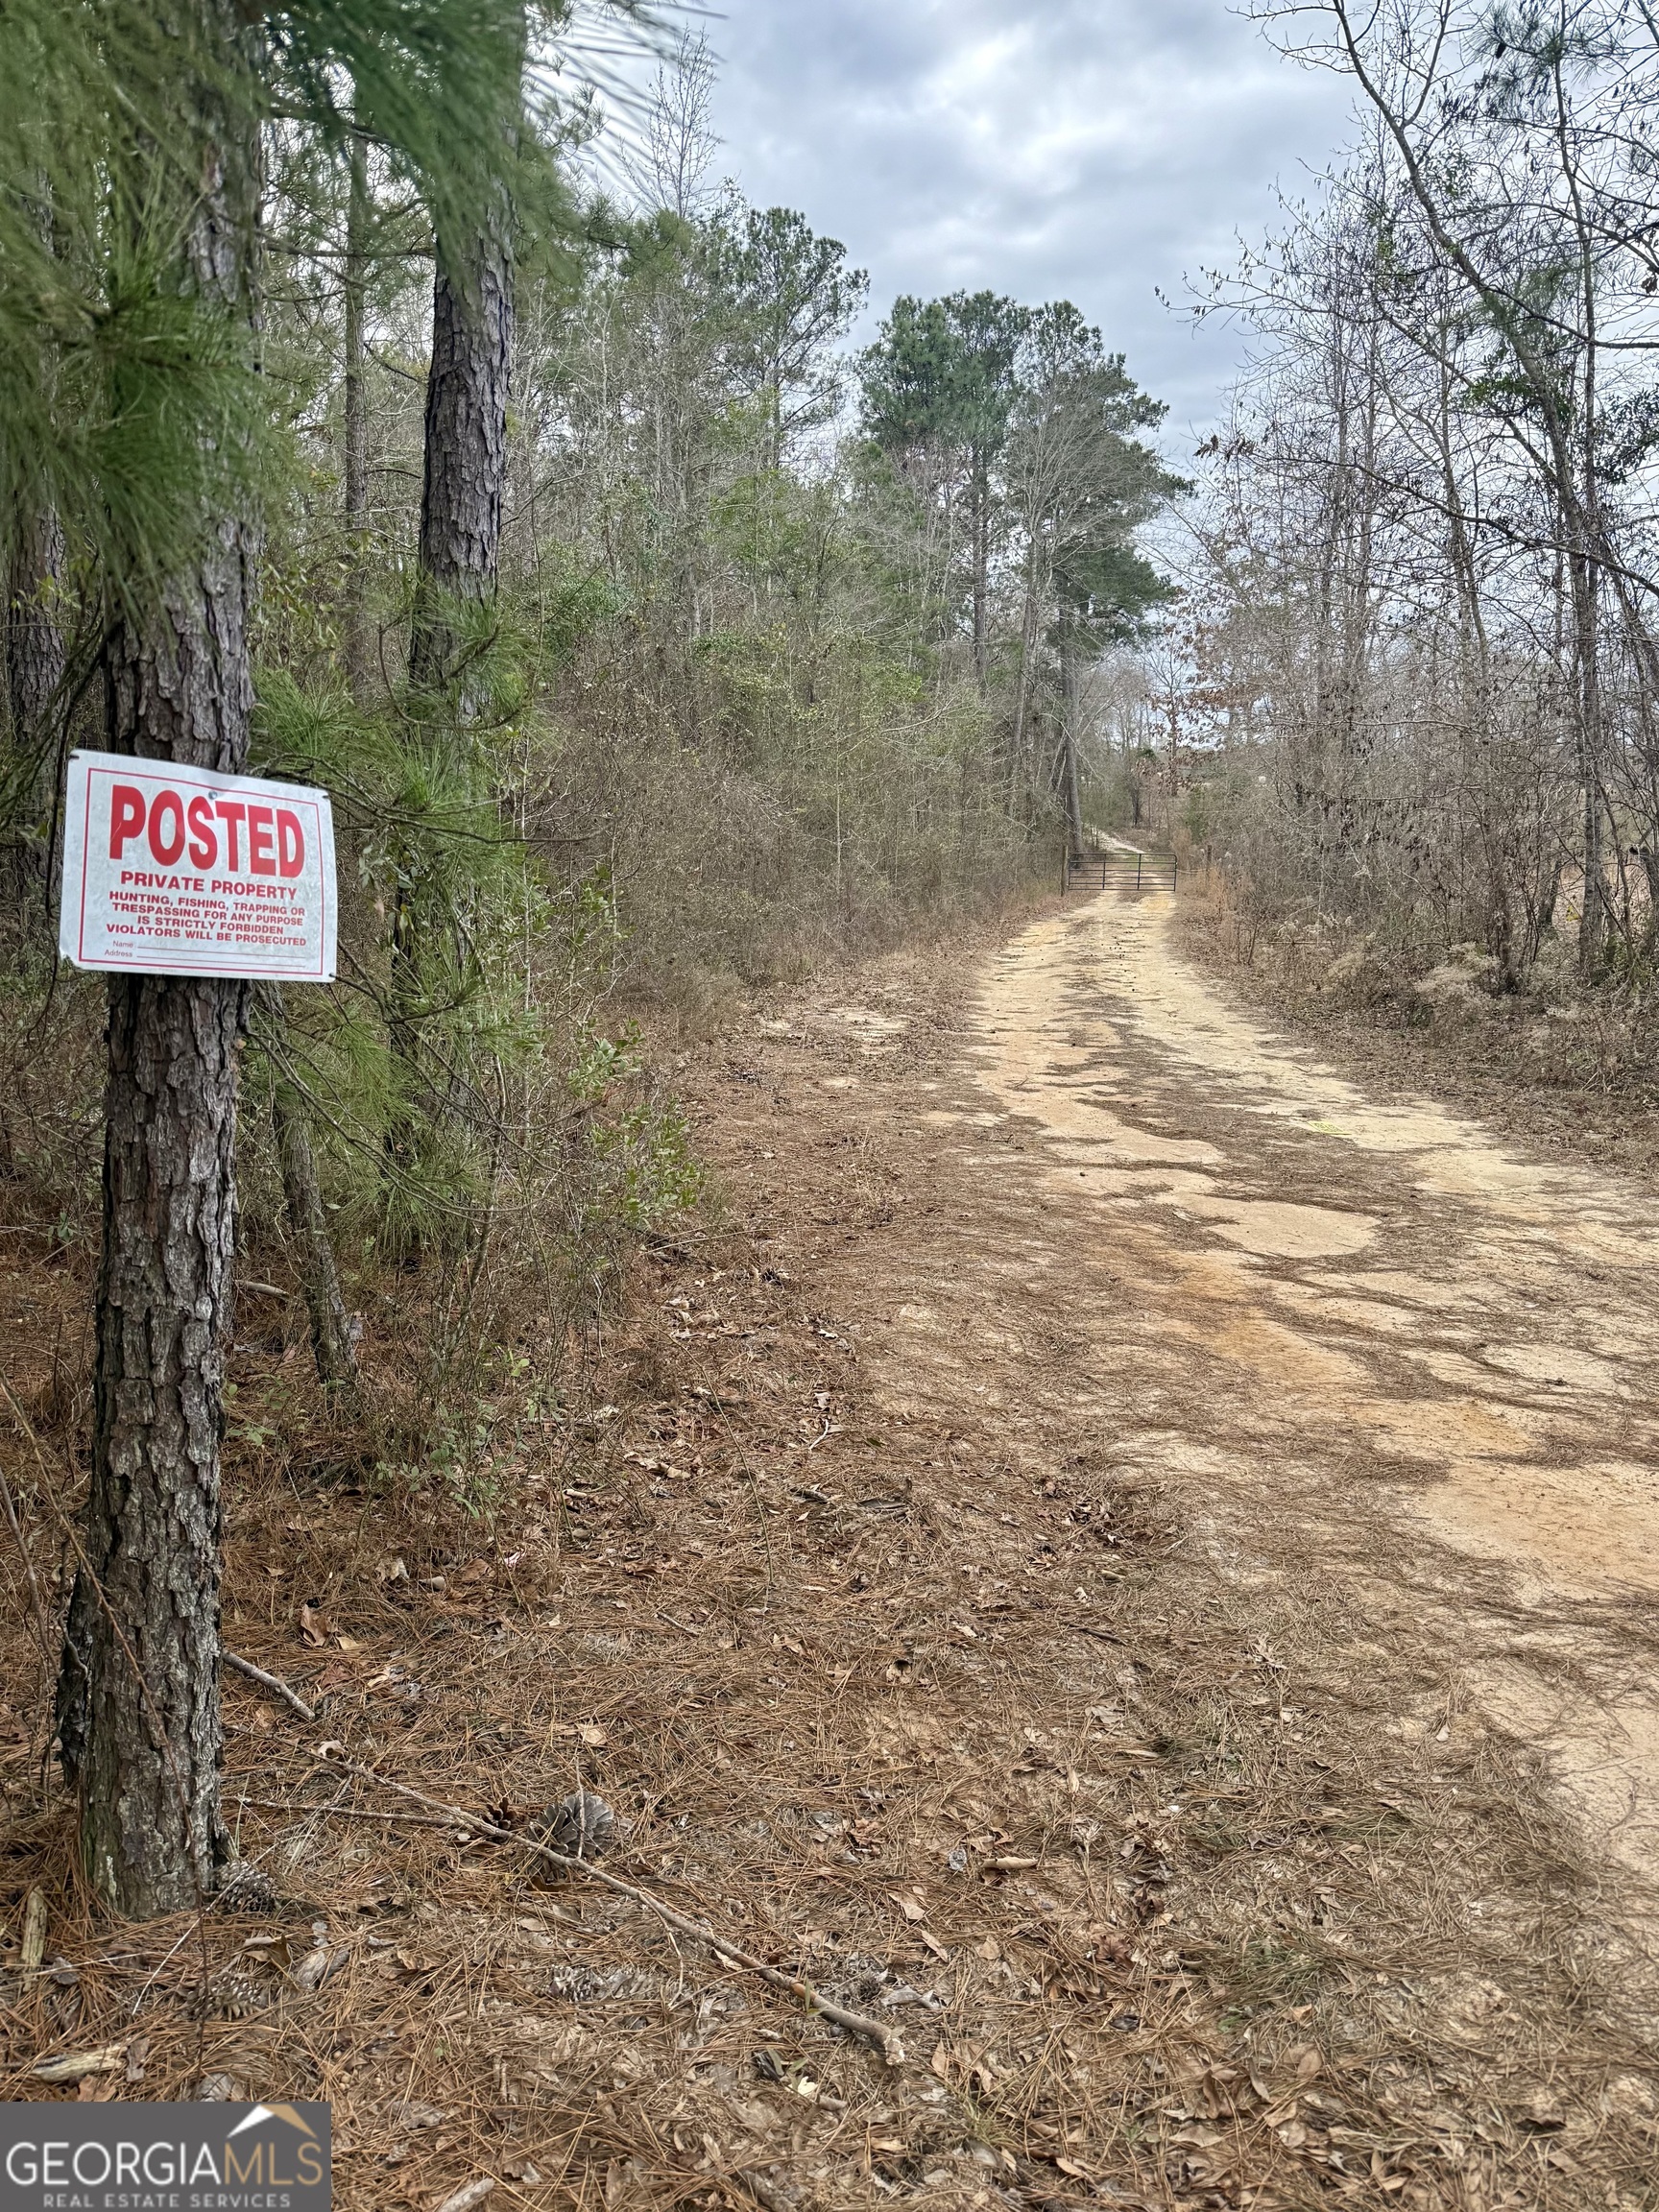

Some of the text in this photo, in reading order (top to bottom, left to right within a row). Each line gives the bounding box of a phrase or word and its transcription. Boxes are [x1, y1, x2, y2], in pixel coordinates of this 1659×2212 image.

[108, 784, 305, 878] POSTED
[121, 871, 297, 900] PRIVATE PROPERTY
[109, 892, 304, 916] HUNTING, FISHING, TRAPPING OR
[112, 902, 302, 926] TRESPASSING FOR ANY PURPOSE
[107, 924, 180, 937] VIOLATORS
[185, 930, 212, 940] WILL
[235, 934, 306, 946] PROSECUTED
[137, 916, 283, 934] IS STRICTLY FORBIDDEN
